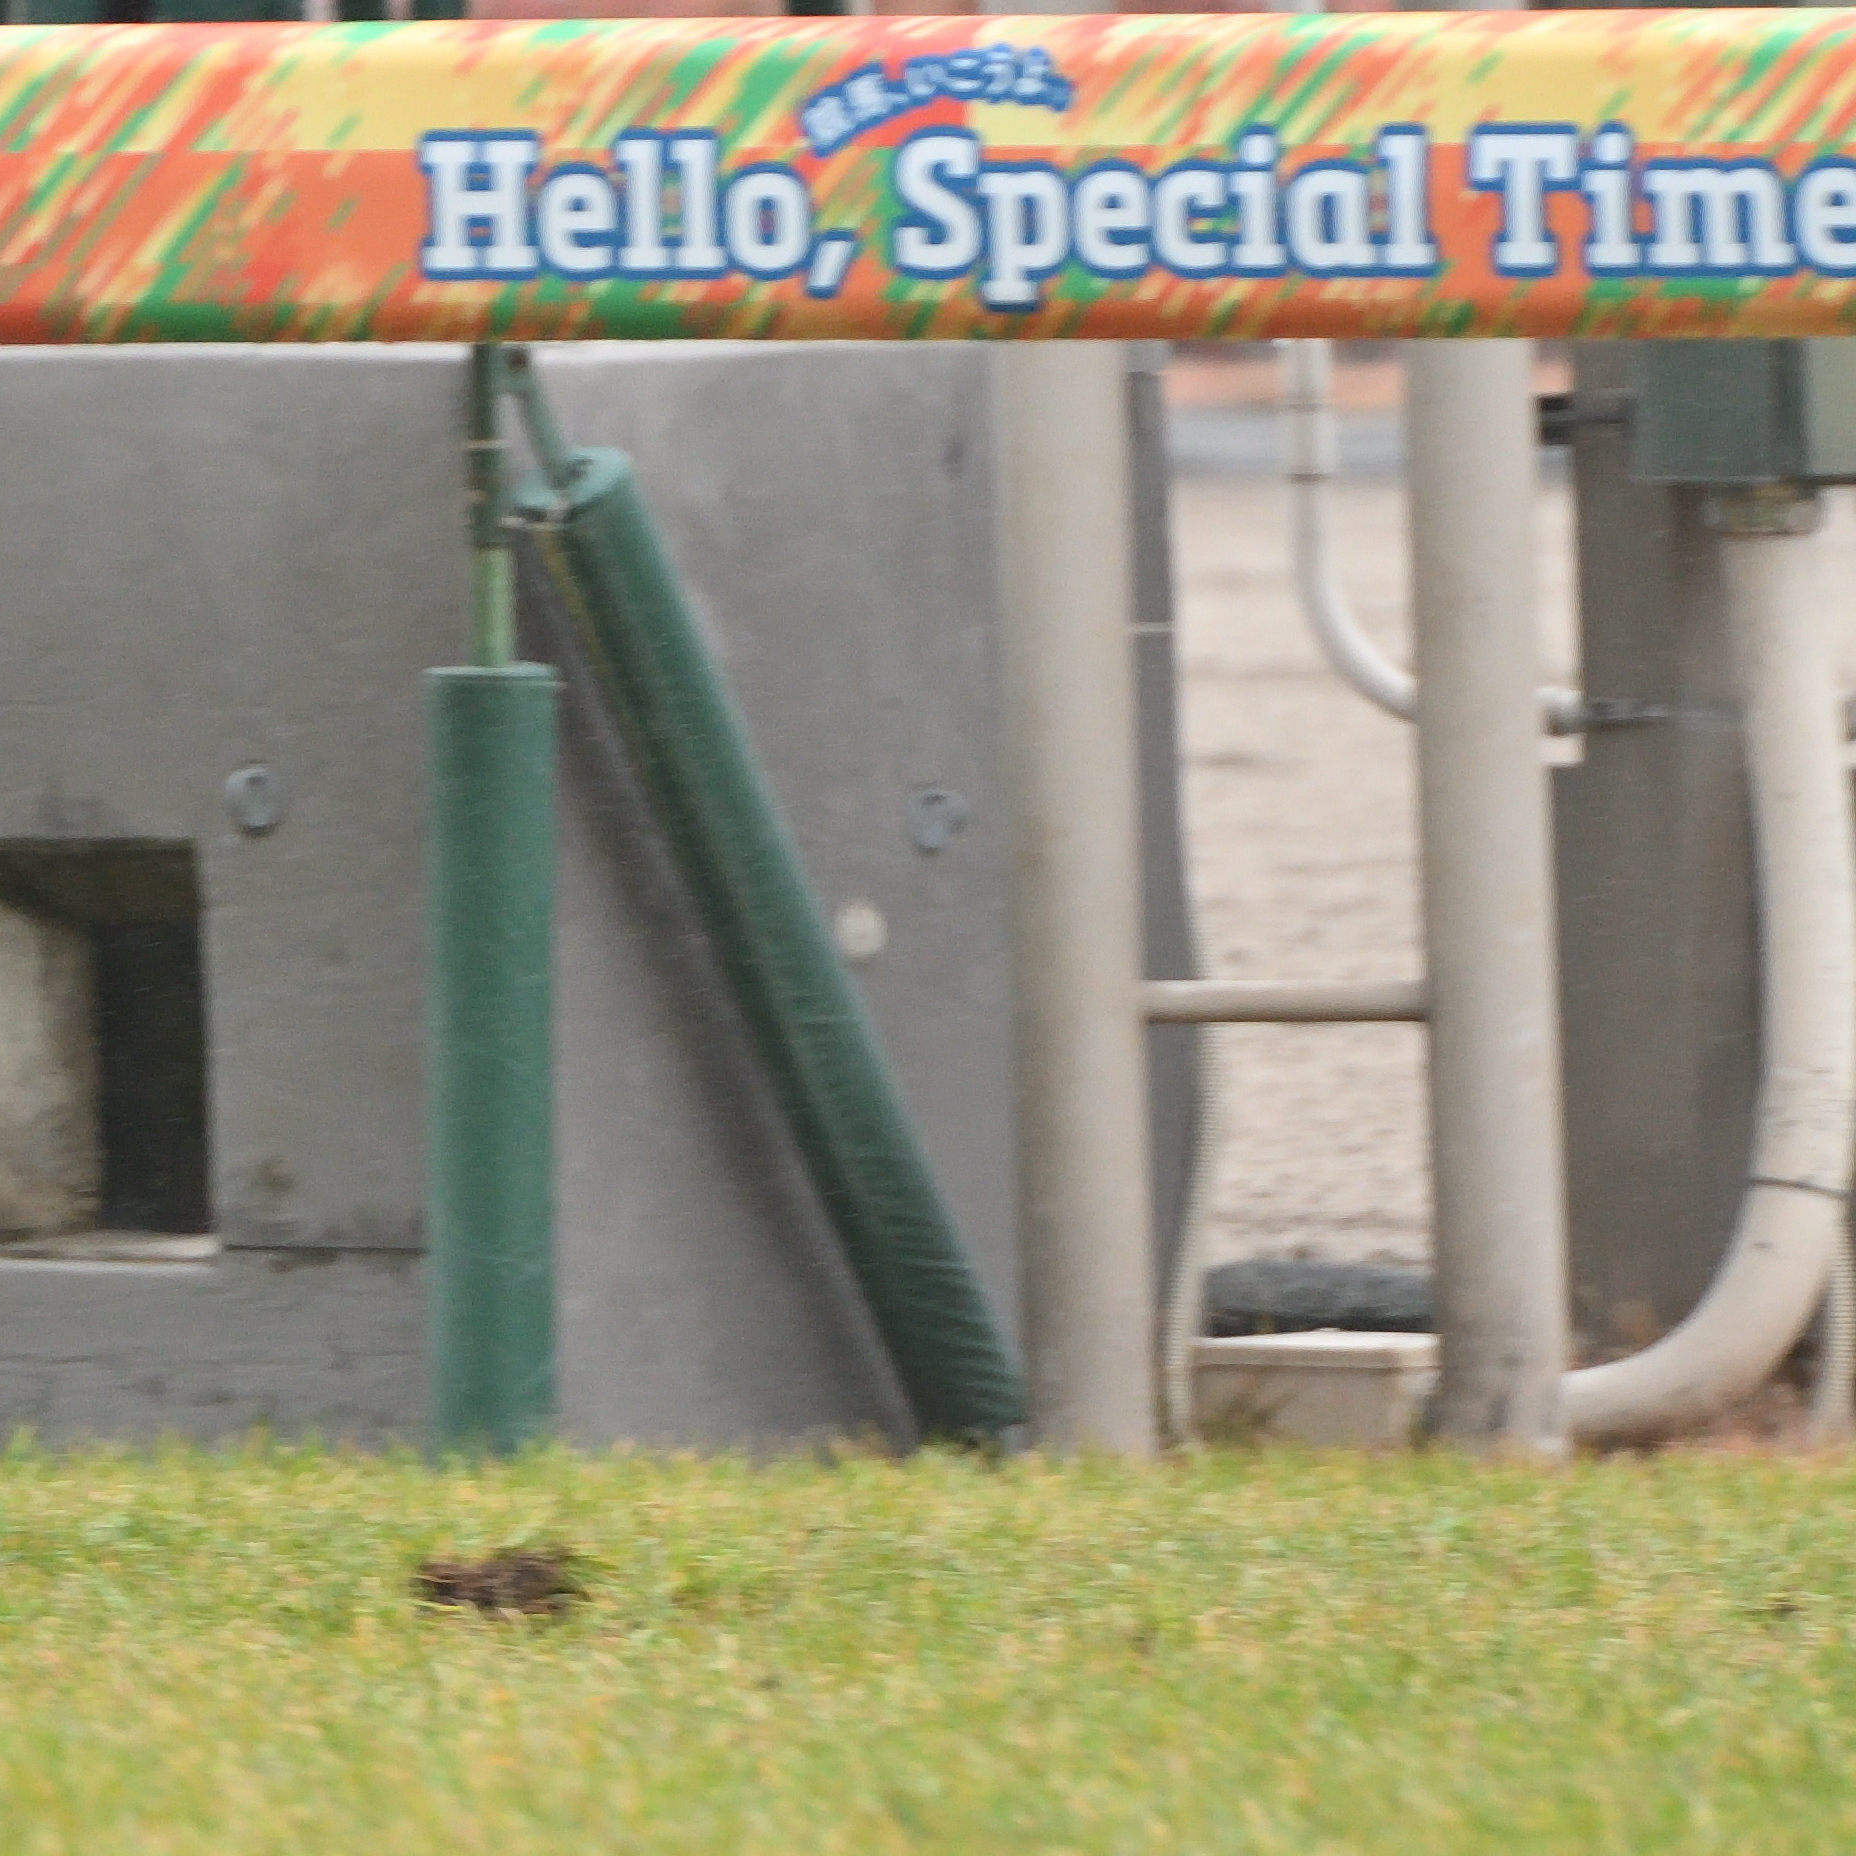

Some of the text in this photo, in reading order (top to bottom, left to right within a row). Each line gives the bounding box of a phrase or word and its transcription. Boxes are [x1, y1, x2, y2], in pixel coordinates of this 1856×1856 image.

[418, 120, 1856, 310] Hello, Special Time
